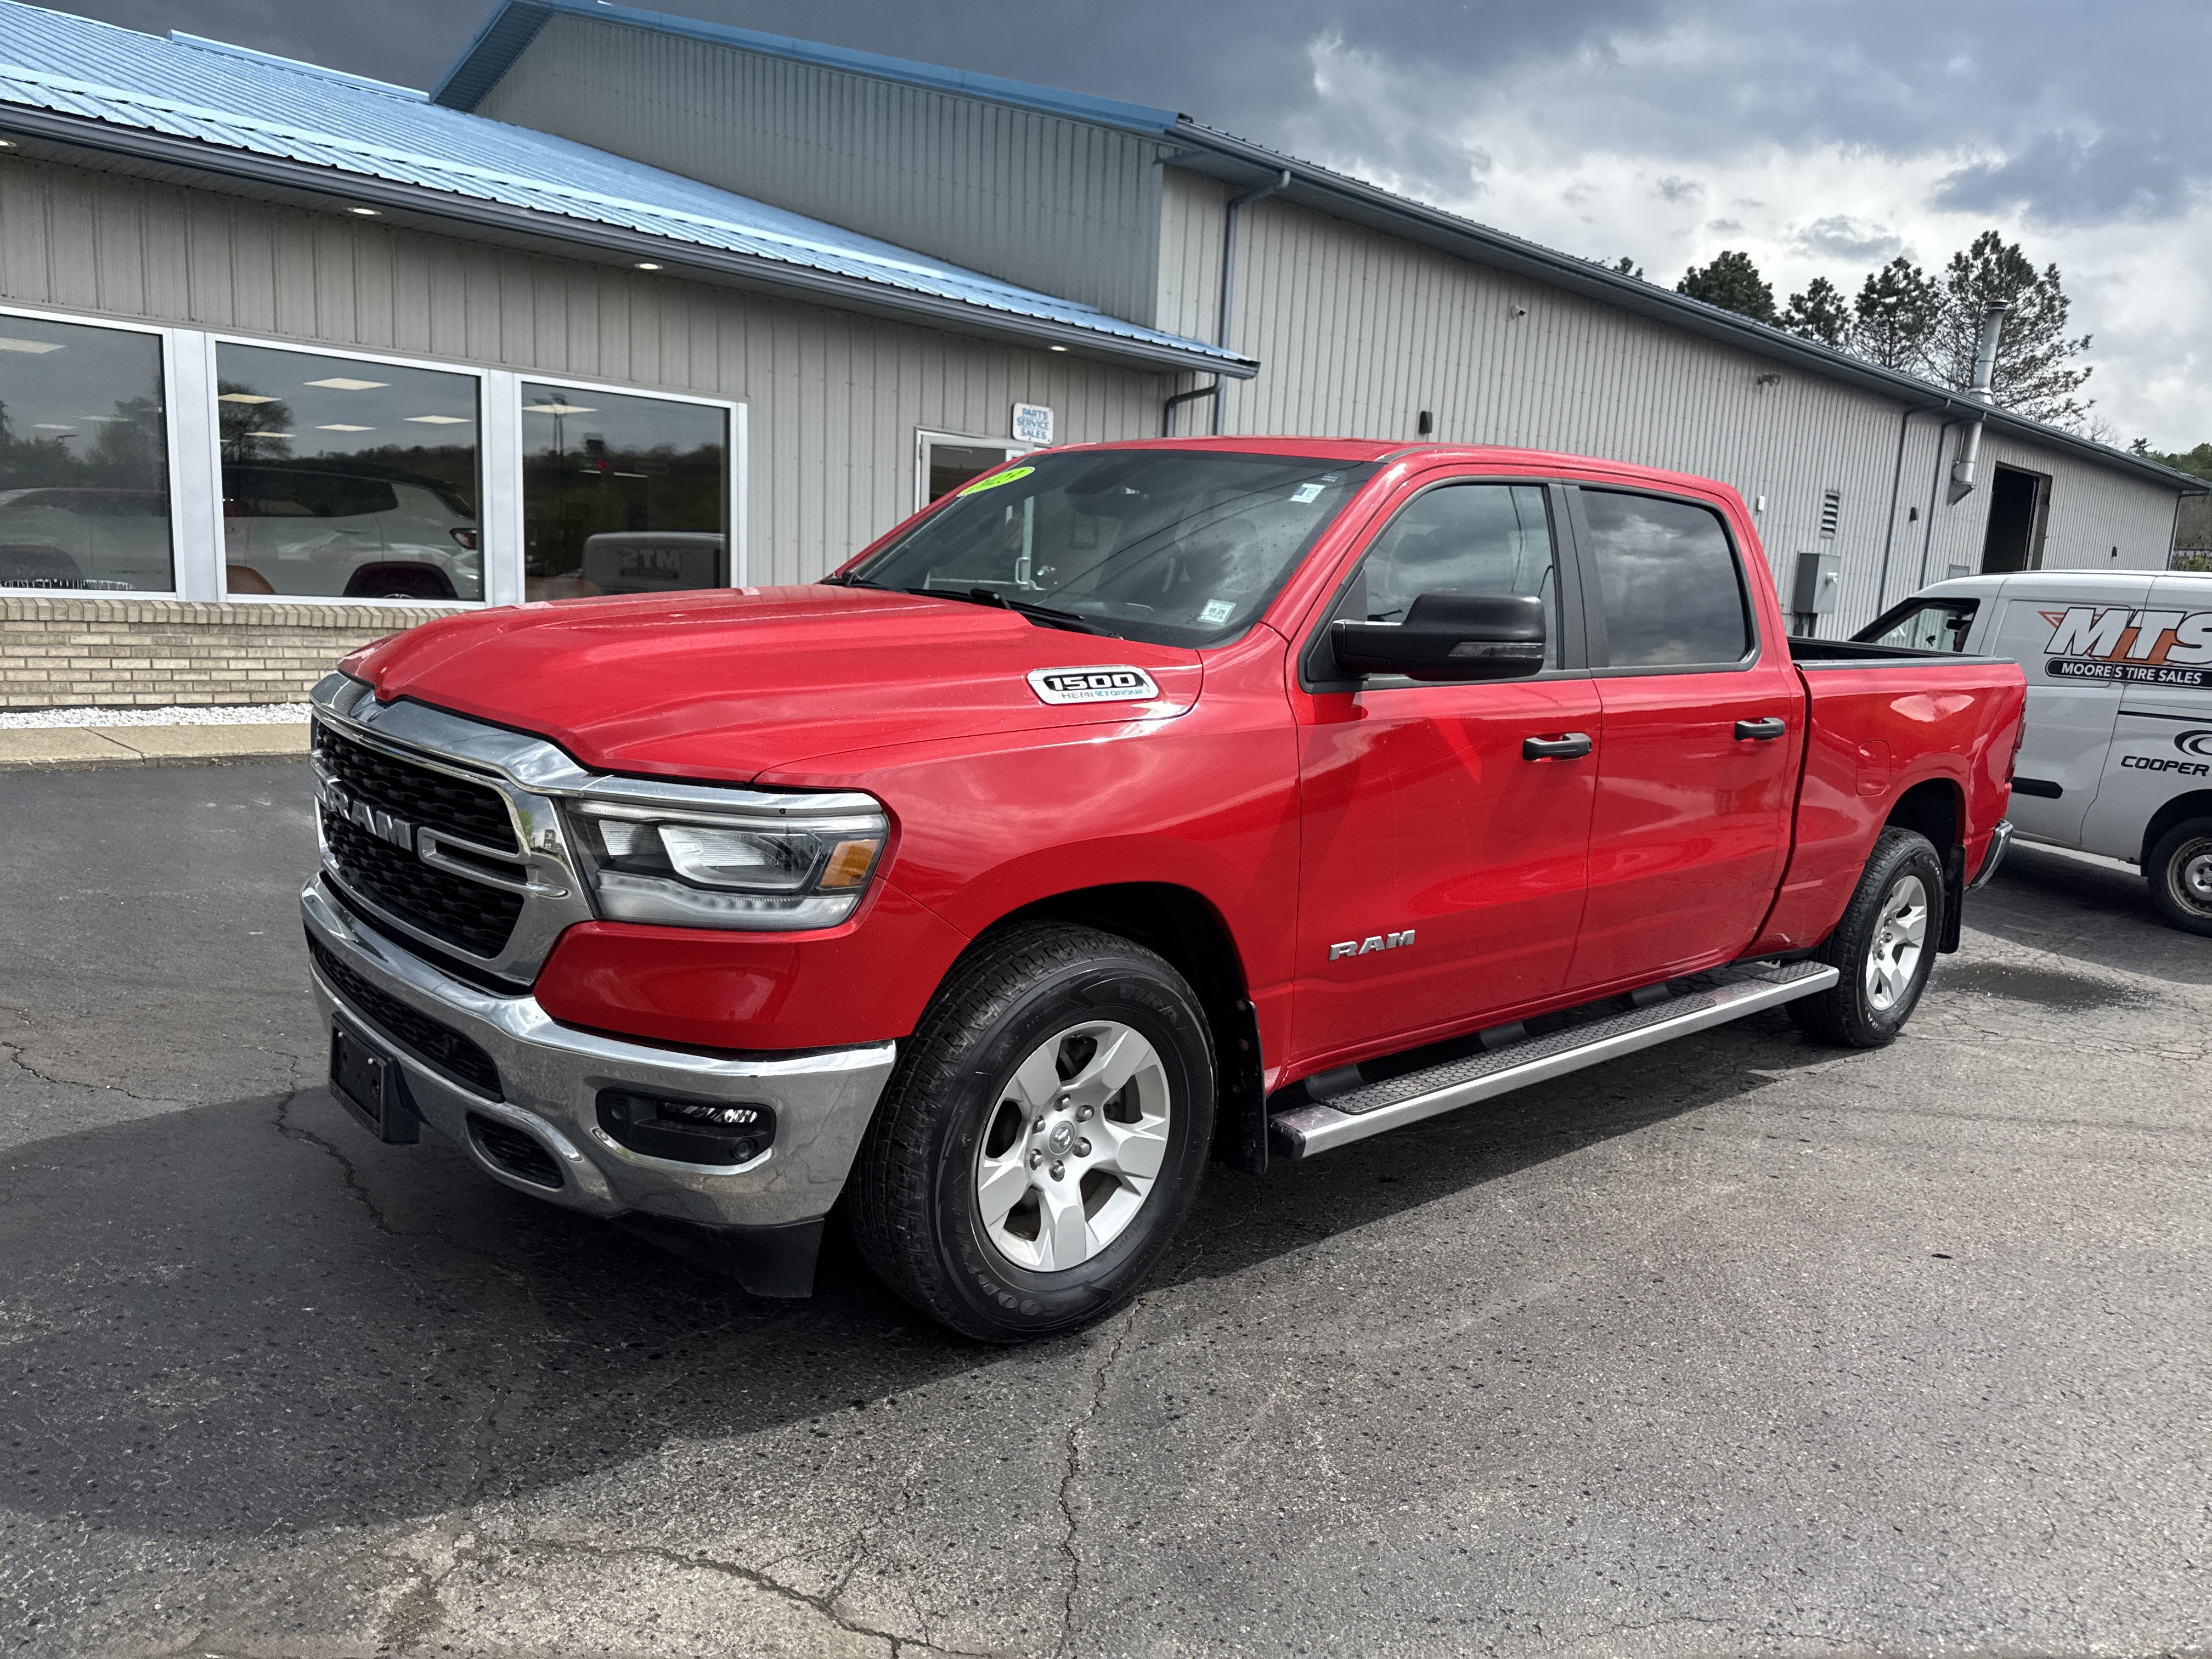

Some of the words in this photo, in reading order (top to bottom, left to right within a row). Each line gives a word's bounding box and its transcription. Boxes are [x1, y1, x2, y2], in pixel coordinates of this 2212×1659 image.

[1017, 417, 1049, 430] SERVICE
[1022, 408, 1048, 420] PARTS
[1020, 428, 1046, 439] SALES
[2044, 606, 2212, 665] MTS
[1048, 674, 1136, 691] 1500
[2061, 662, 2124, 678] MOORES
[2126, 667, 2156, 681] TIRE
[2158, 670, 2202, 684] SALES
[2120, 755, 2210, 777] COOPER
[328, 782, 413, 852] RAM
[1329, 929, 1415, 961] RAM
